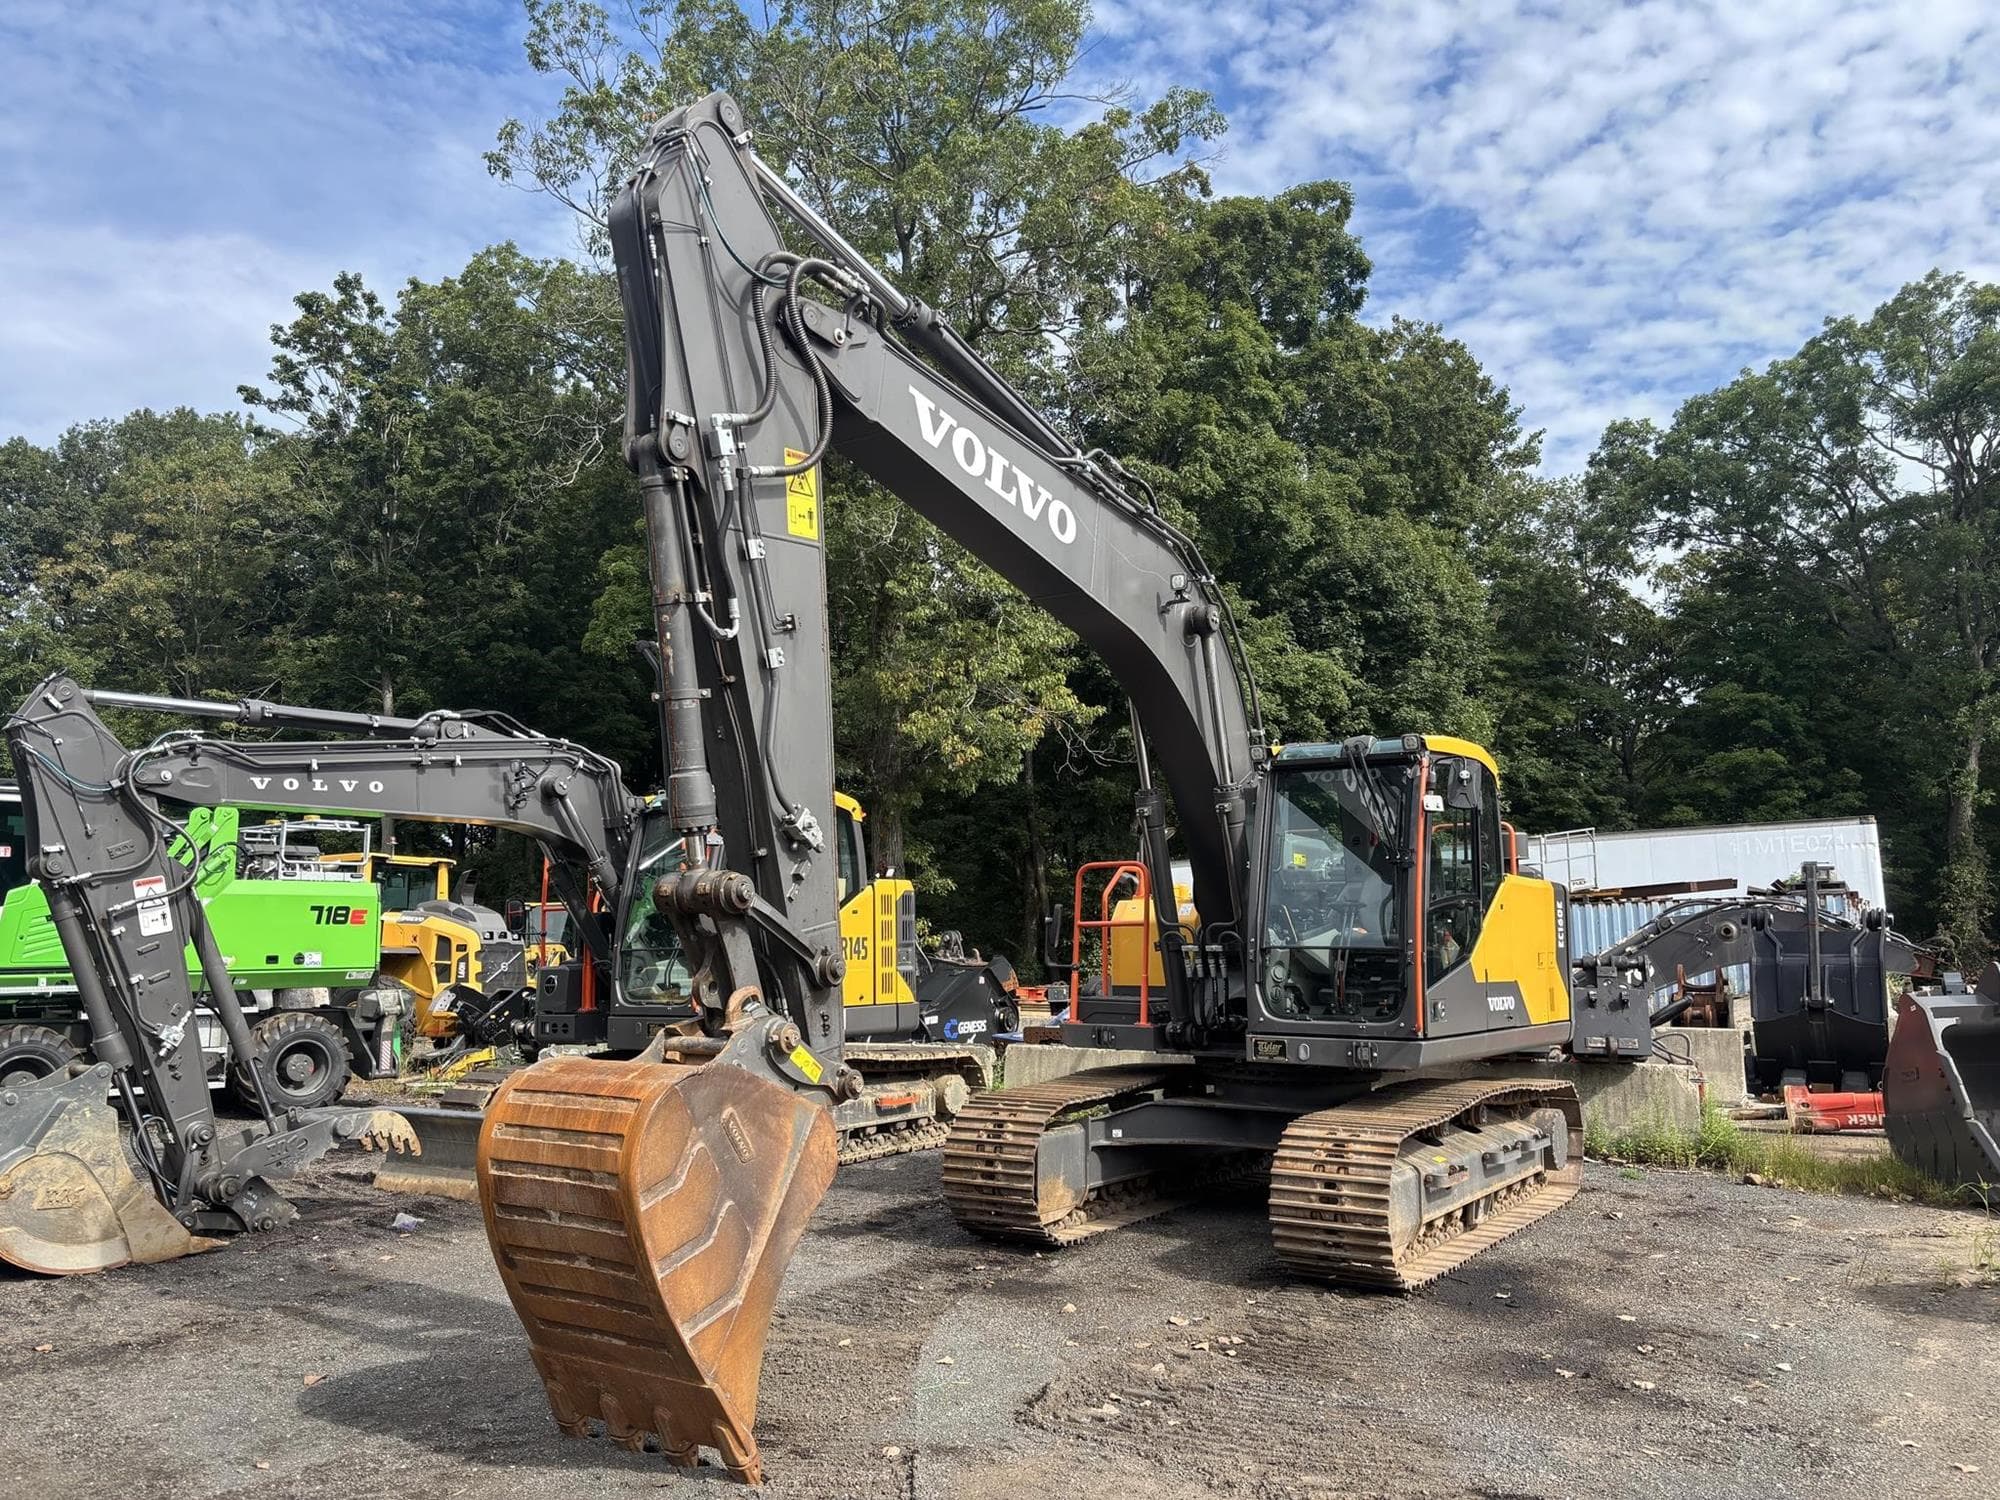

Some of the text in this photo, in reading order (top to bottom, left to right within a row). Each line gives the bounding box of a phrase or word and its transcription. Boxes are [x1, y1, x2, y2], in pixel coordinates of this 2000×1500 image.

[908, 384, 1077, 544] VOLVO
[249, 777, 384, 793] VOLVO
[310, 905, 368, 925] 718E
[1487, 996, 1515, 1011] VOLVO
[957, 1019, 987, 1034] GENESIS
